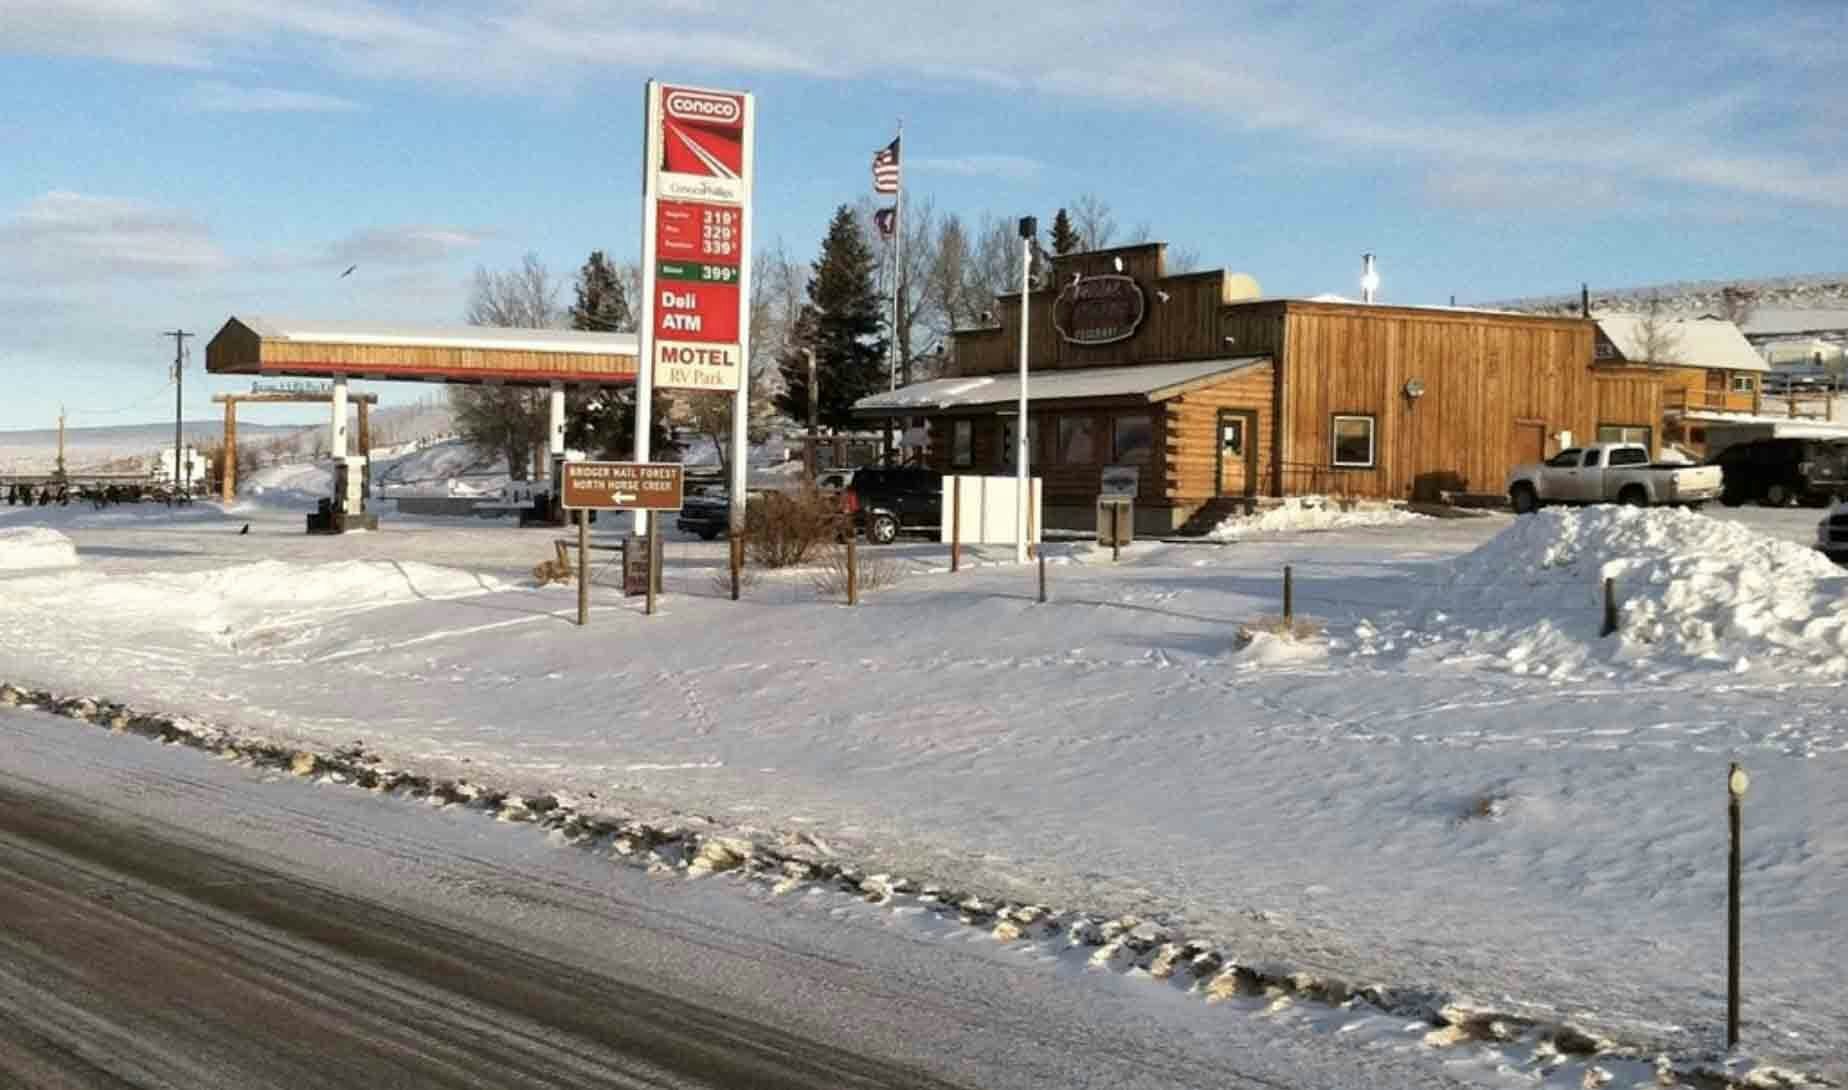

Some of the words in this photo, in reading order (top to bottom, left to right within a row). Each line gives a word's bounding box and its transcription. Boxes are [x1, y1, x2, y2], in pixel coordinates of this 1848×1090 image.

[661, 291, 696, 309] Deli
[661, 313, 702, 332] ATM
[661, 346, 735, 367] MOTEL
[670, 367, 691, 384] RV
[694, 369, 727, 385] Park
[640, 468, 678, 480] FOREST
[573, 479, 606, 489] NORTH
[607, 480, 639, 491] HORSE
[641, 480, 673, 491] CREEK
